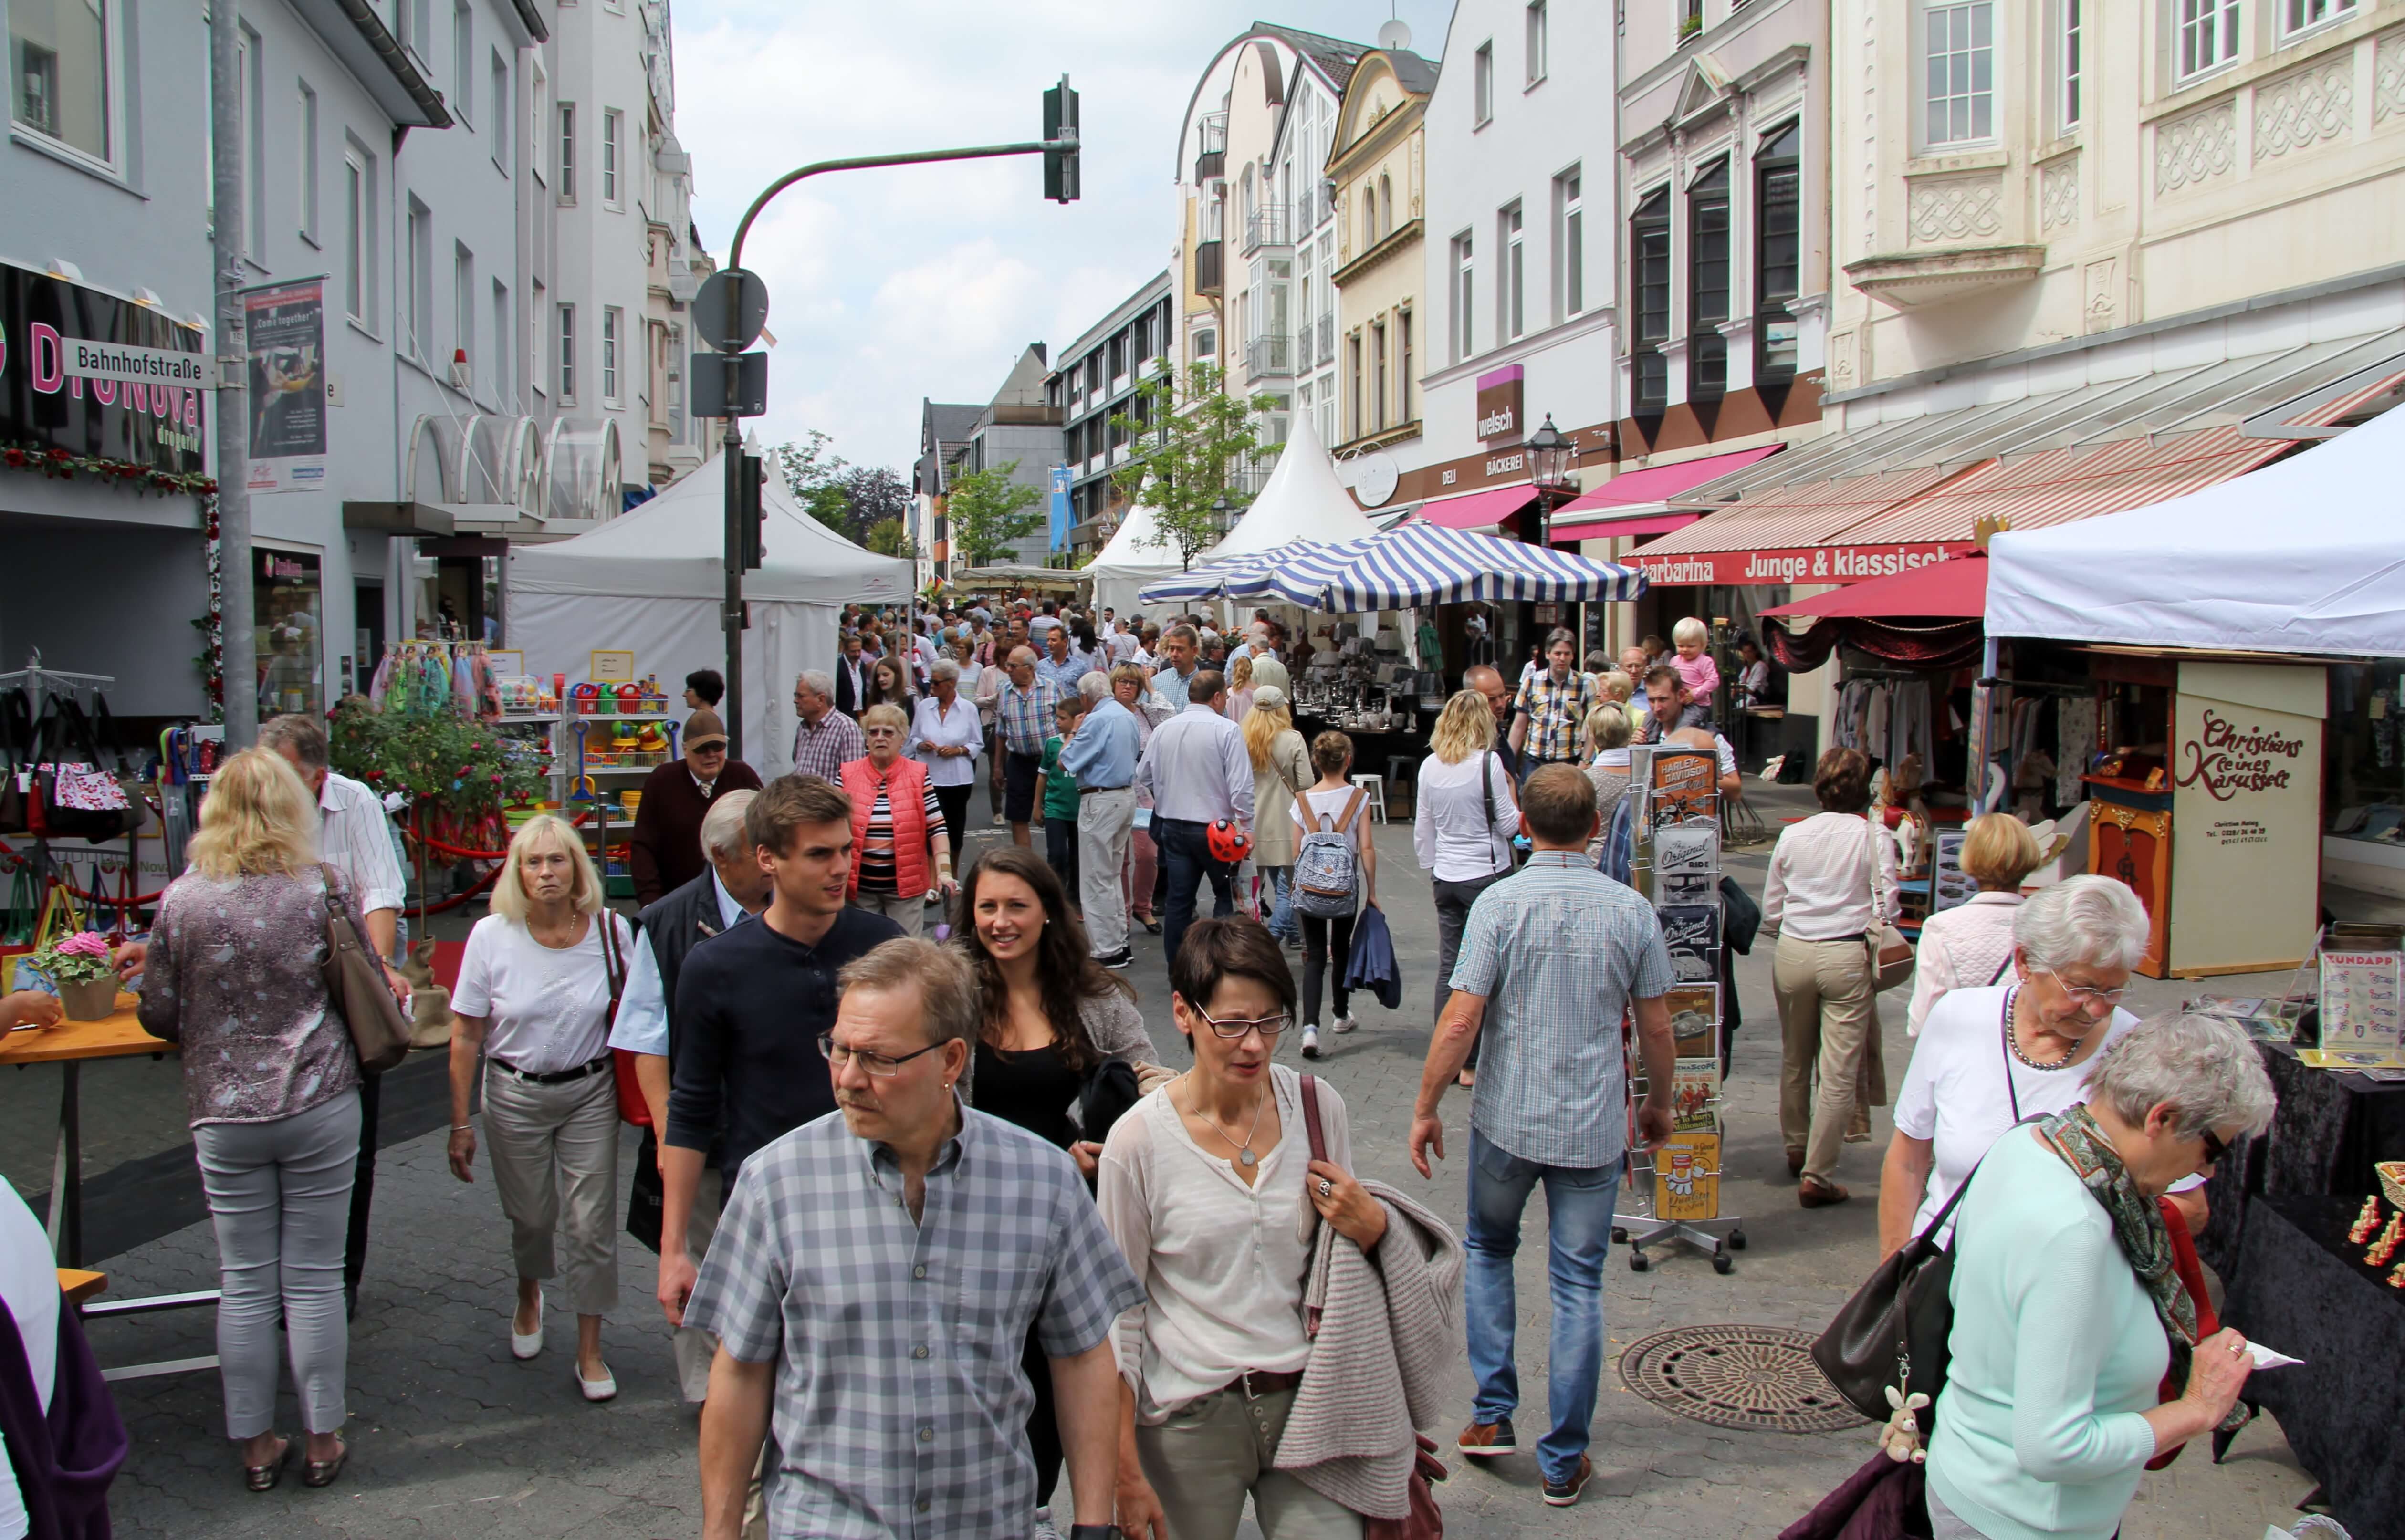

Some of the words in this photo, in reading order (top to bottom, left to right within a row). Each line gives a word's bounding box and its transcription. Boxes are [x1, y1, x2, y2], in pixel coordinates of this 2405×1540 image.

[78, 346, 201, 380] Bahnhofstraße
[1478, 406, 1513, 437] welsch
[157, 425, 199, 453] drogerie
[1442, 469, 1457, 485] DELI
[1486, 454, 1523, 477] BÄCKEREI
[1640, 555, 1714, 583] barbarina
[1745, 553, 1807, 583] Junge
[1813, 550, 1829, 576] &
[2203, 709, 2303, 758] Christians
[1662, 758, 1699, 774] HARLEY-
[1665, 764, 1708, 783] DAVIDSON
[1662, 838, 1708, 866] Original
[1663, 914, 1711, 943] Original
